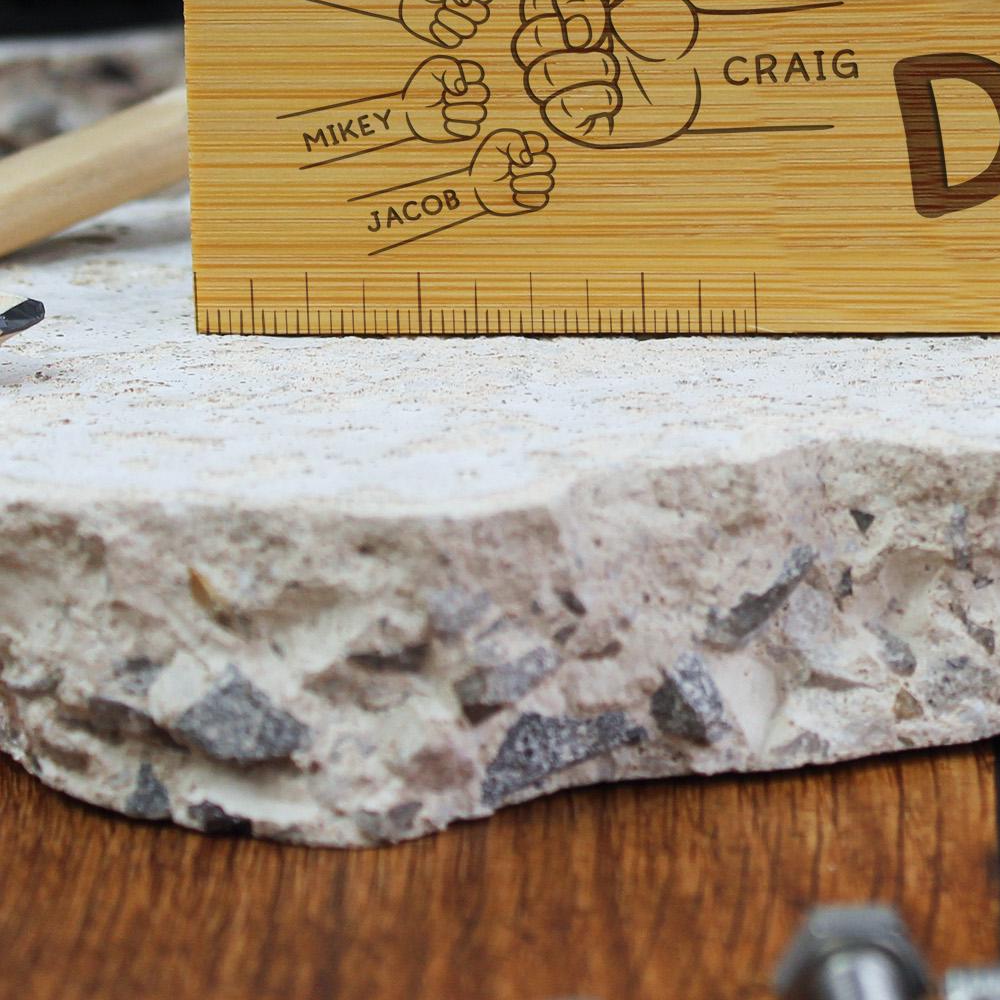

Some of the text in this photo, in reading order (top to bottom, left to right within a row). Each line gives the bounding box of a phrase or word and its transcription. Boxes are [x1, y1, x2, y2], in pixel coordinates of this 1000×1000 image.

[723, 50, 860, 86] CRAIG
[302, 108, 394, 152] MIKEY
[367, 188, 461, 234] JACOB
